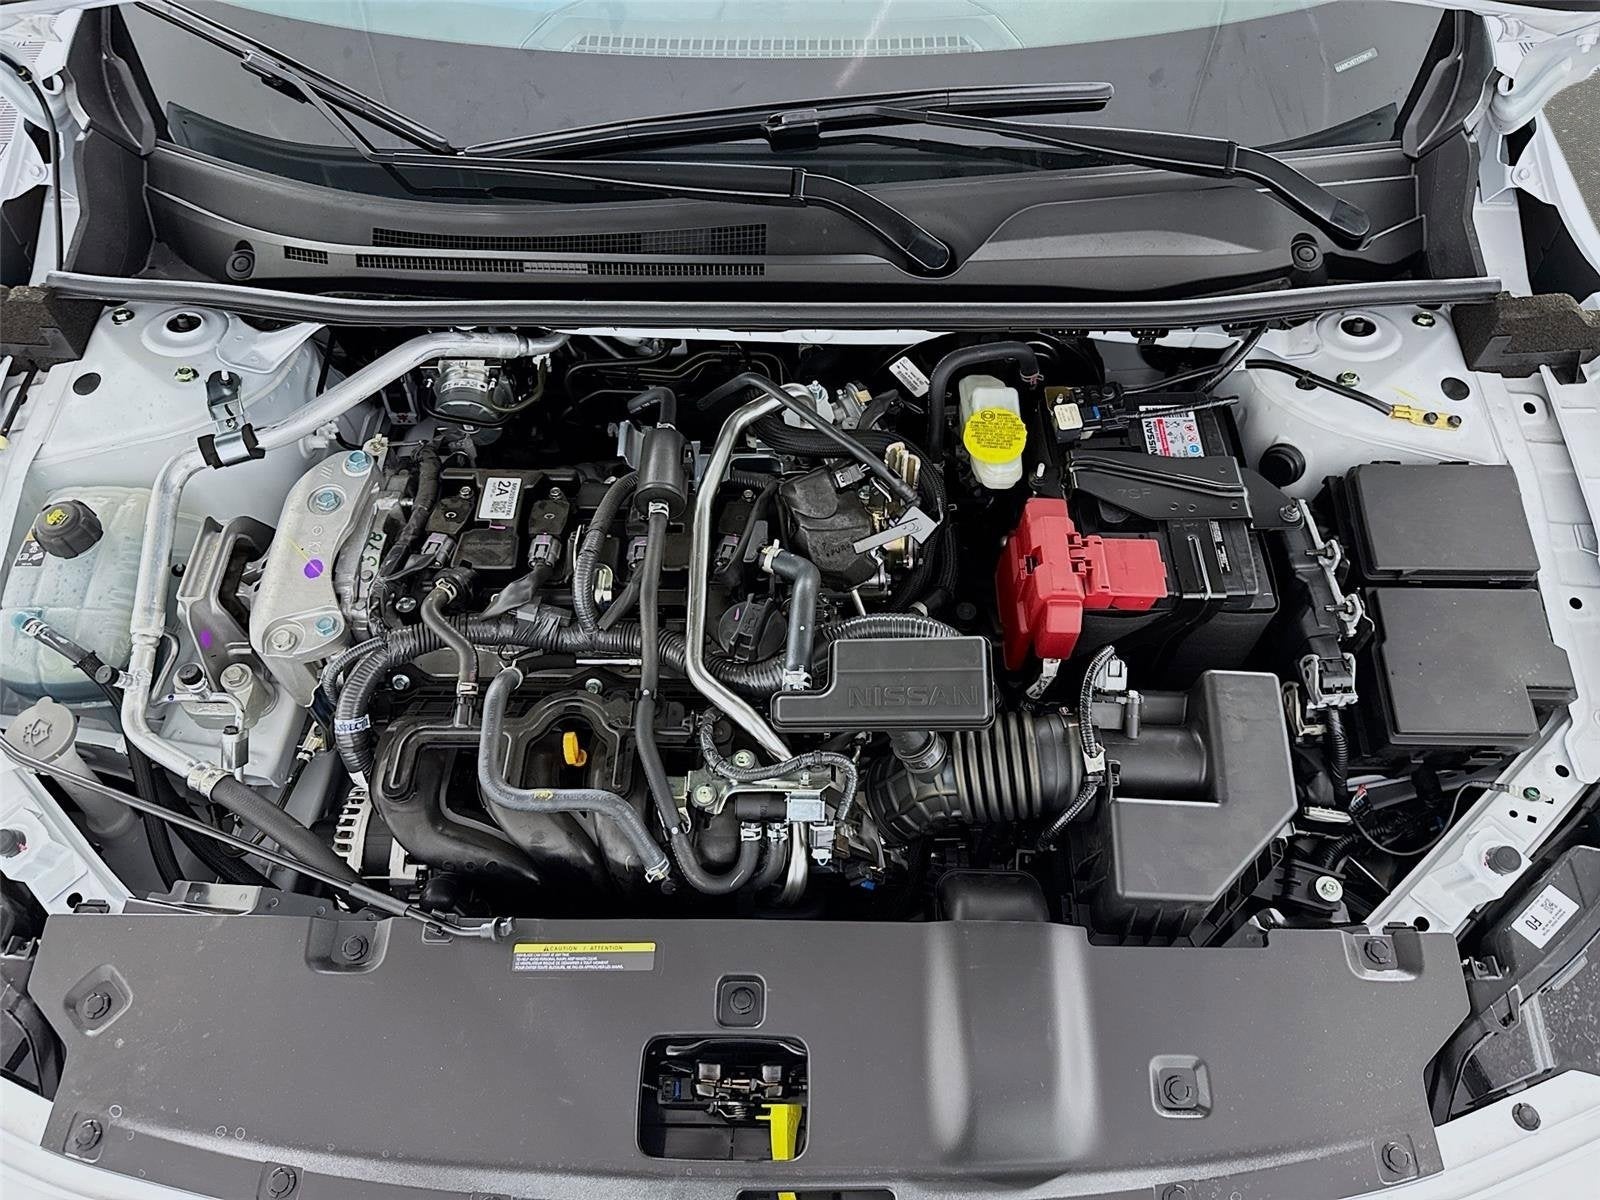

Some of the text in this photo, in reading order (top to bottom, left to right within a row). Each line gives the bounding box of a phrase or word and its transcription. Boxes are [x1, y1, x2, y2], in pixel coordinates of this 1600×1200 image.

[1144, 420, 1158, 455] NISSAN
[495, 481, 511, 496] 2A
[848, 686, 979, 708] NISSAN
